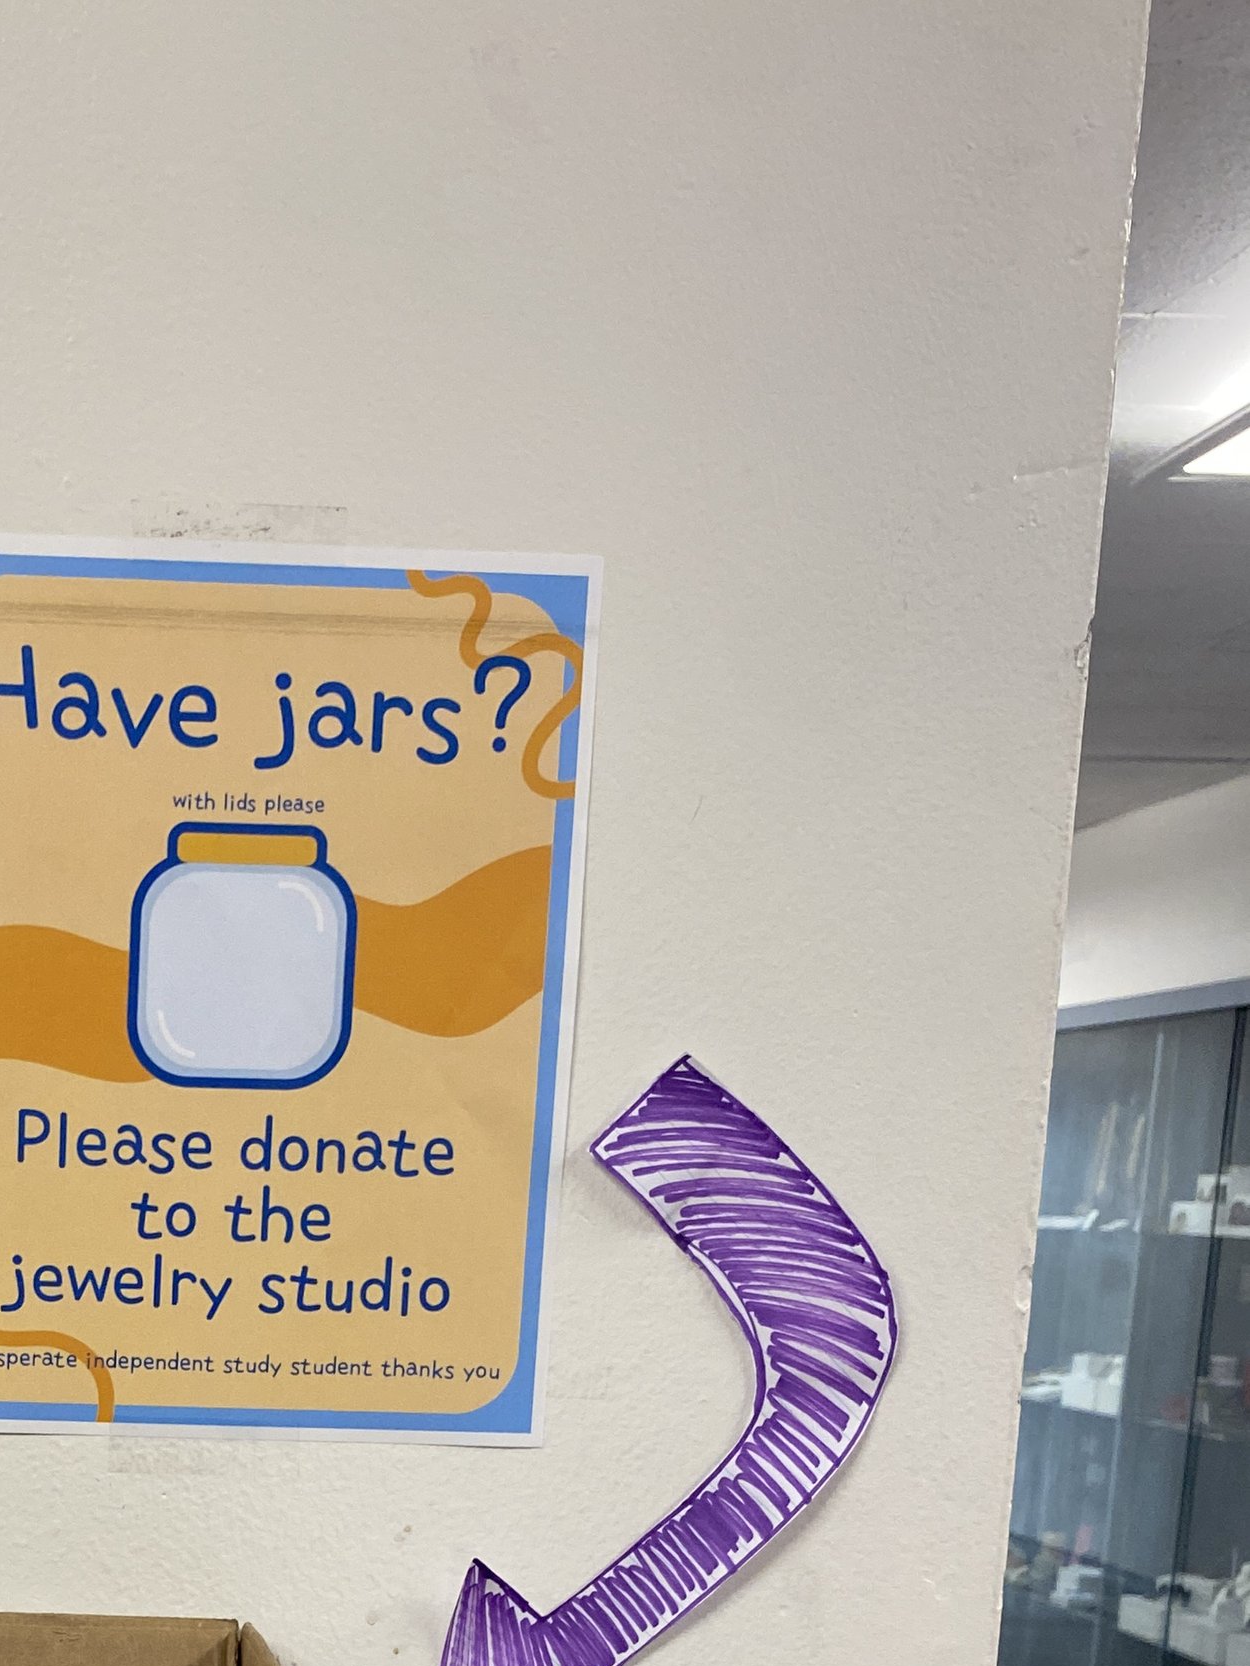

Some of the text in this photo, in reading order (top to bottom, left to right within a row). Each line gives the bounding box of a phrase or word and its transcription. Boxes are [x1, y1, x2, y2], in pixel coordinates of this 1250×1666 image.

[253, 655, 532, 770] jars?
[172, 792, 326, 816] with lids please
[16, 1108, 456, 1178] Please donate
[130, 1185, 332, 1243] to the
[1, 1253, 451, 1320] jewelry studio
[85, 1349, 216, 1375] independent
[222, 1354, 282, 1378] study
[290, 1355, 372, 1377] student
[381, 1356, 455, 1381] thanks
[463, 1364, 501, 1383] you
